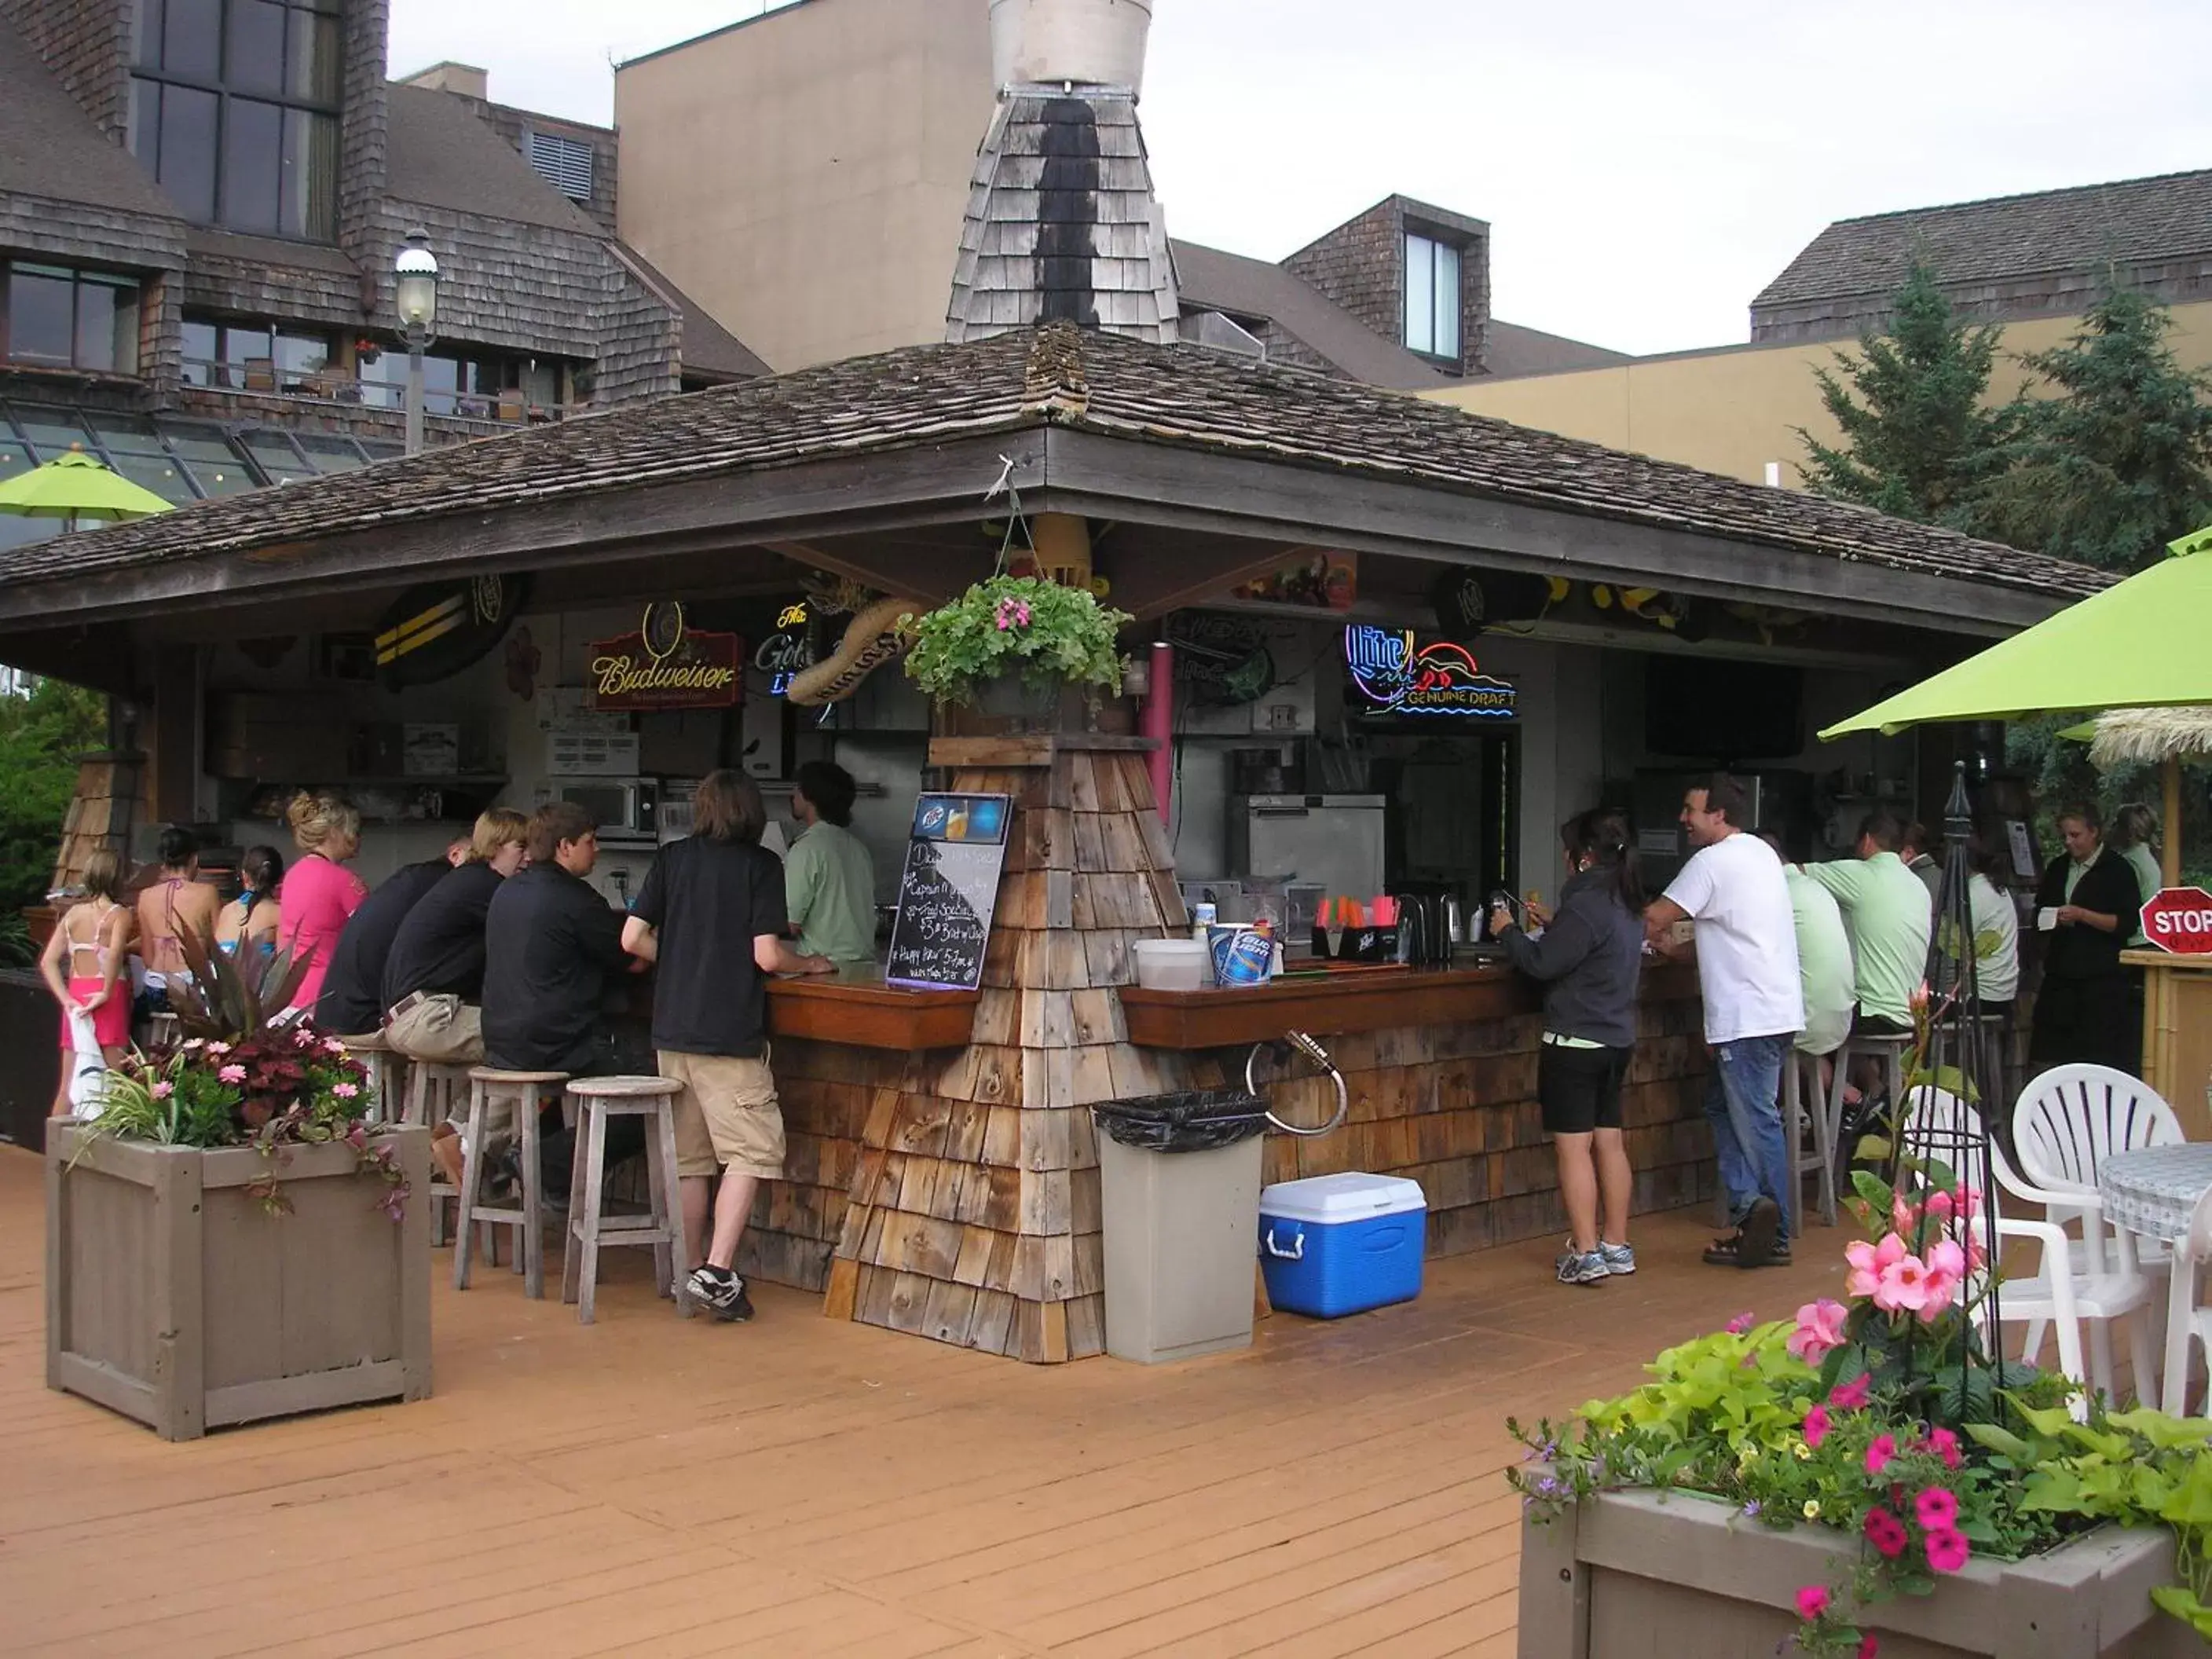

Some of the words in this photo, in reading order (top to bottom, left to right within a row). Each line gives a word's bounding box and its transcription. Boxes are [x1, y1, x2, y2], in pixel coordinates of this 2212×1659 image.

[592, 655, 735, 695] Budweiser
[1408, 690, 1467, 705] GENUINE
[1470, 690, 1517, 706] DRAFT
[2155, 910, 2212, 934] STOP
